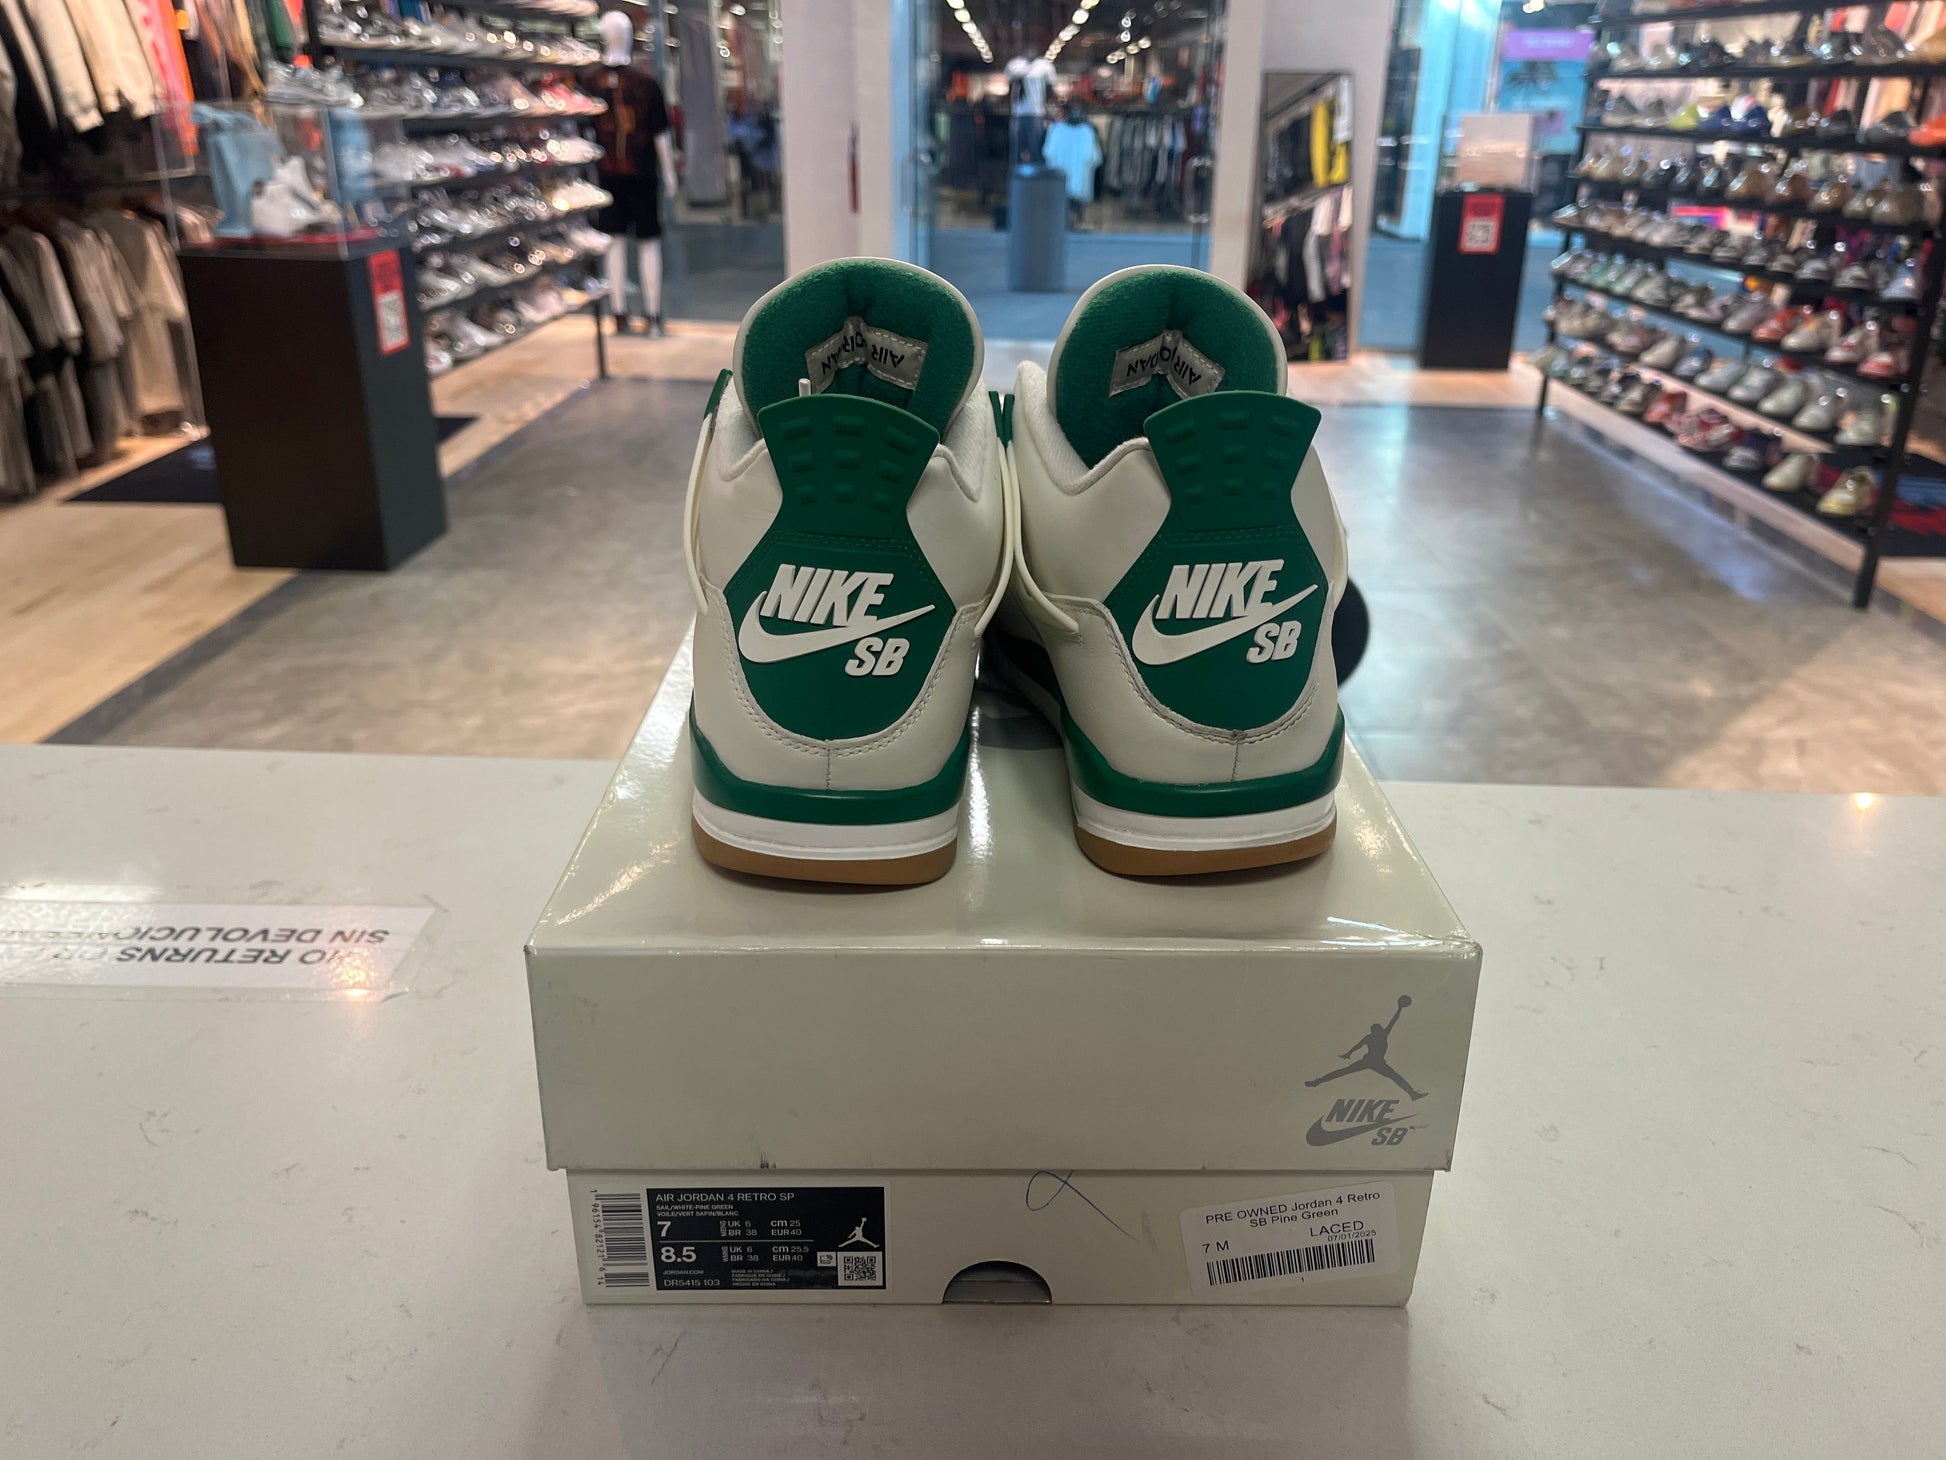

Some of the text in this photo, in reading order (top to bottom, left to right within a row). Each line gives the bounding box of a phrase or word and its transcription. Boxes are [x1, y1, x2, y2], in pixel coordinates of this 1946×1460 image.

[871, 344, 905, 368] AIR
[1174, 355, 1202, 385] AIR
[760, 563, 894, 627] NIKE
[1156, 558, 1285, 621] NIKE
[1246, 619, 1302, 664] SB
[844, 637, 910, 677] SB
[330, 928, 390, 946] SIN
[117, 945, 292, 966] RETURNS
[1324, 1098, 1400, 1123] NIKE
[1371, 1127, 1409, 1146] SB
[655, 1192, 795, 1202] AIR JORDAN 4 RETRO SP
[1205, 1192, 1381, 1225] PRE OWNED Jordan 4 Retro
[727, 1220, 752, 1228] UK 6
[770, 1219, 801, 1227] cm 25
[1249, 1208, 1339, 1228] SB Pine Green
[657, 1220, 672, 1237] 7
[728, 1229, 758, 1237] BR 38
[1310, 1220, 1364, 1237] LACED
[1327, 1230, 1377, 1242] 07/01/2025
[660, 1246, 697, 1263] 8.5
[772, 1245, 810, 1253] cm 25.5
[1202, 1240, 1230, 1254] 7 M
[730, 1254, 760, 1262] BR 38
[663, 1278, 721, 1287] DR5415 103
